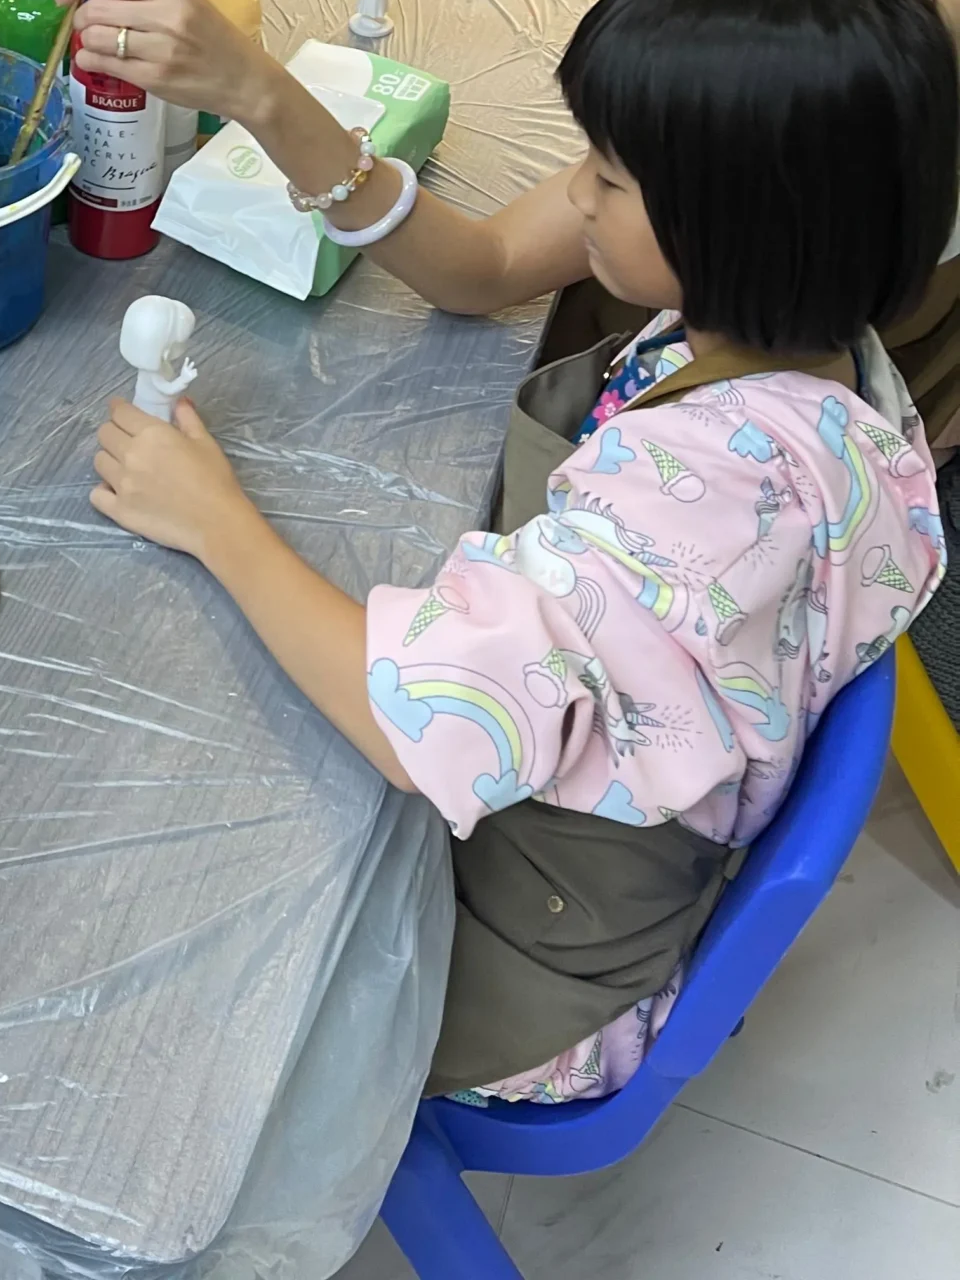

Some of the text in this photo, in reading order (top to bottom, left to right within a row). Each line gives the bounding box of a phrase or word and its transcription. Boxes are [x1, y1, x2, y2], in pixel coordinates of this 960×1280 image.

[371, 73, 402, 97] 80
[91, 94, 139, 109] BRAQUE
[83, 122, 136, 138] GALE-
[83, 145, 137, 160] ACRYL
